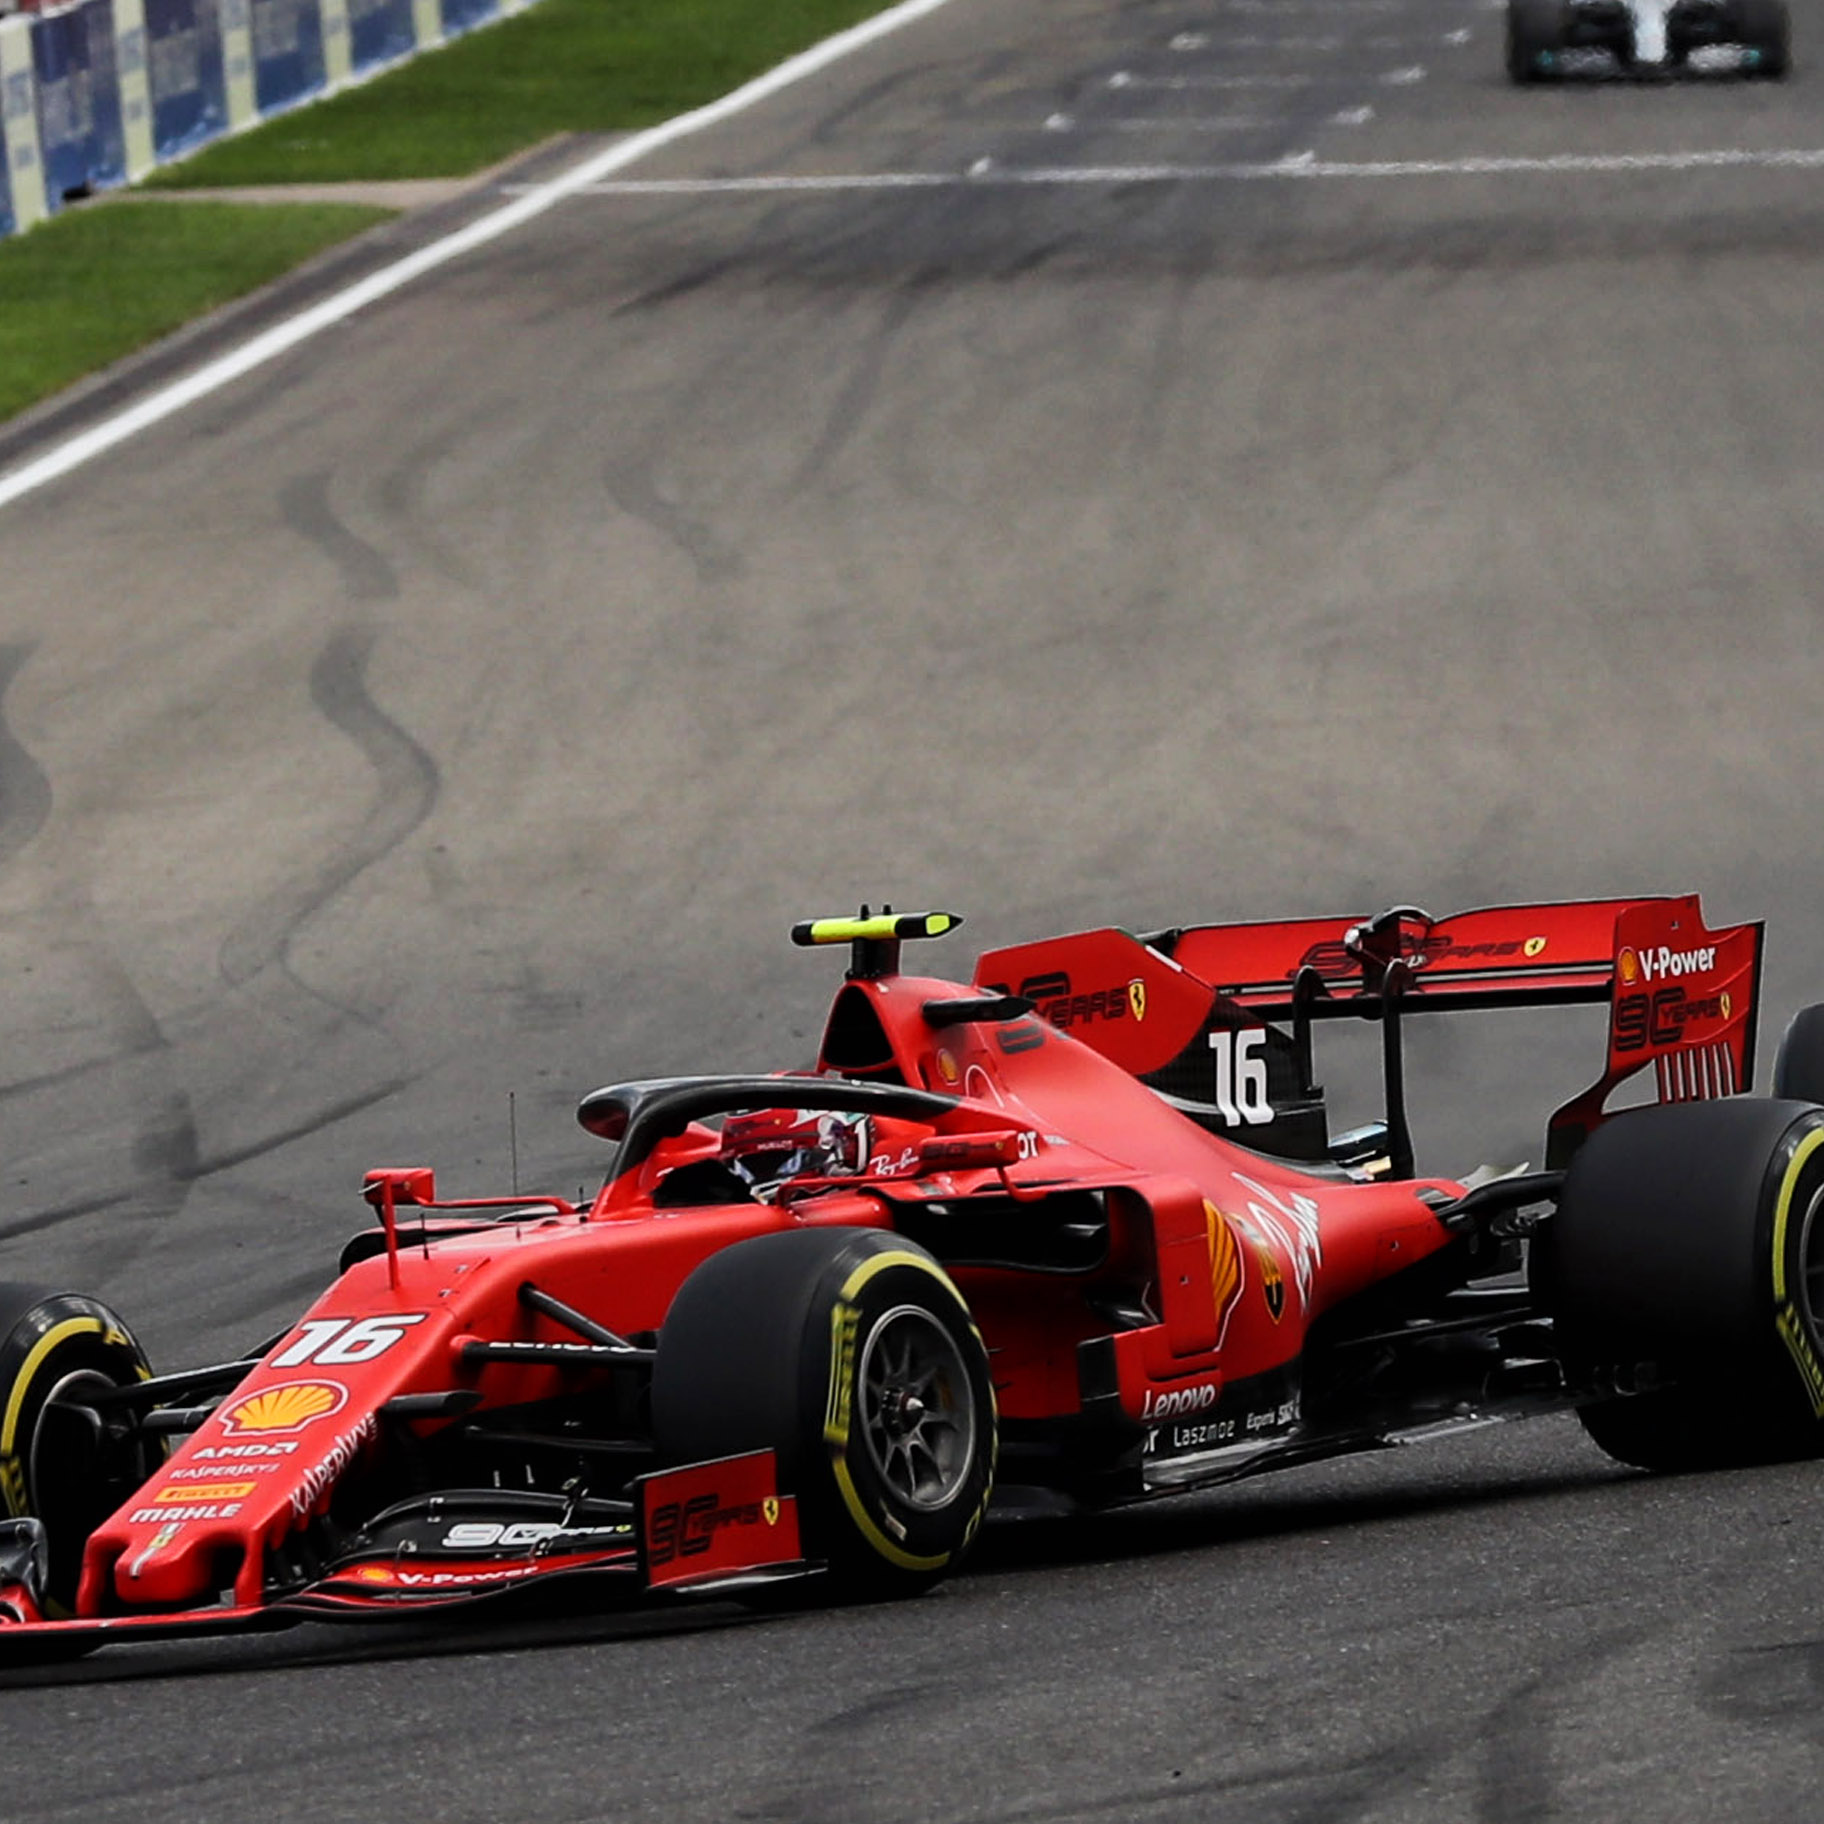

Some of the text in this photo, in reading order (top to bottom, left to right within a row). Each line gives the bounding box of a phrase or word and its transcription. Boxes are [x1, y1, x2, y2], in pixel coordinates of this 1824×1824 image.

[1638, 946, 1716, 982] V-Power
[1208, 1027, 1275, 1127] 16
[269, 1314, 428, 1368] 16
[1141, 1383, 1216, 1421] Lenovo
[191, 1443, 272, 1460] AMD
[129, 1503, 243, 1524] MAHLE
[397, 1565, 539, 1585] V-Power
